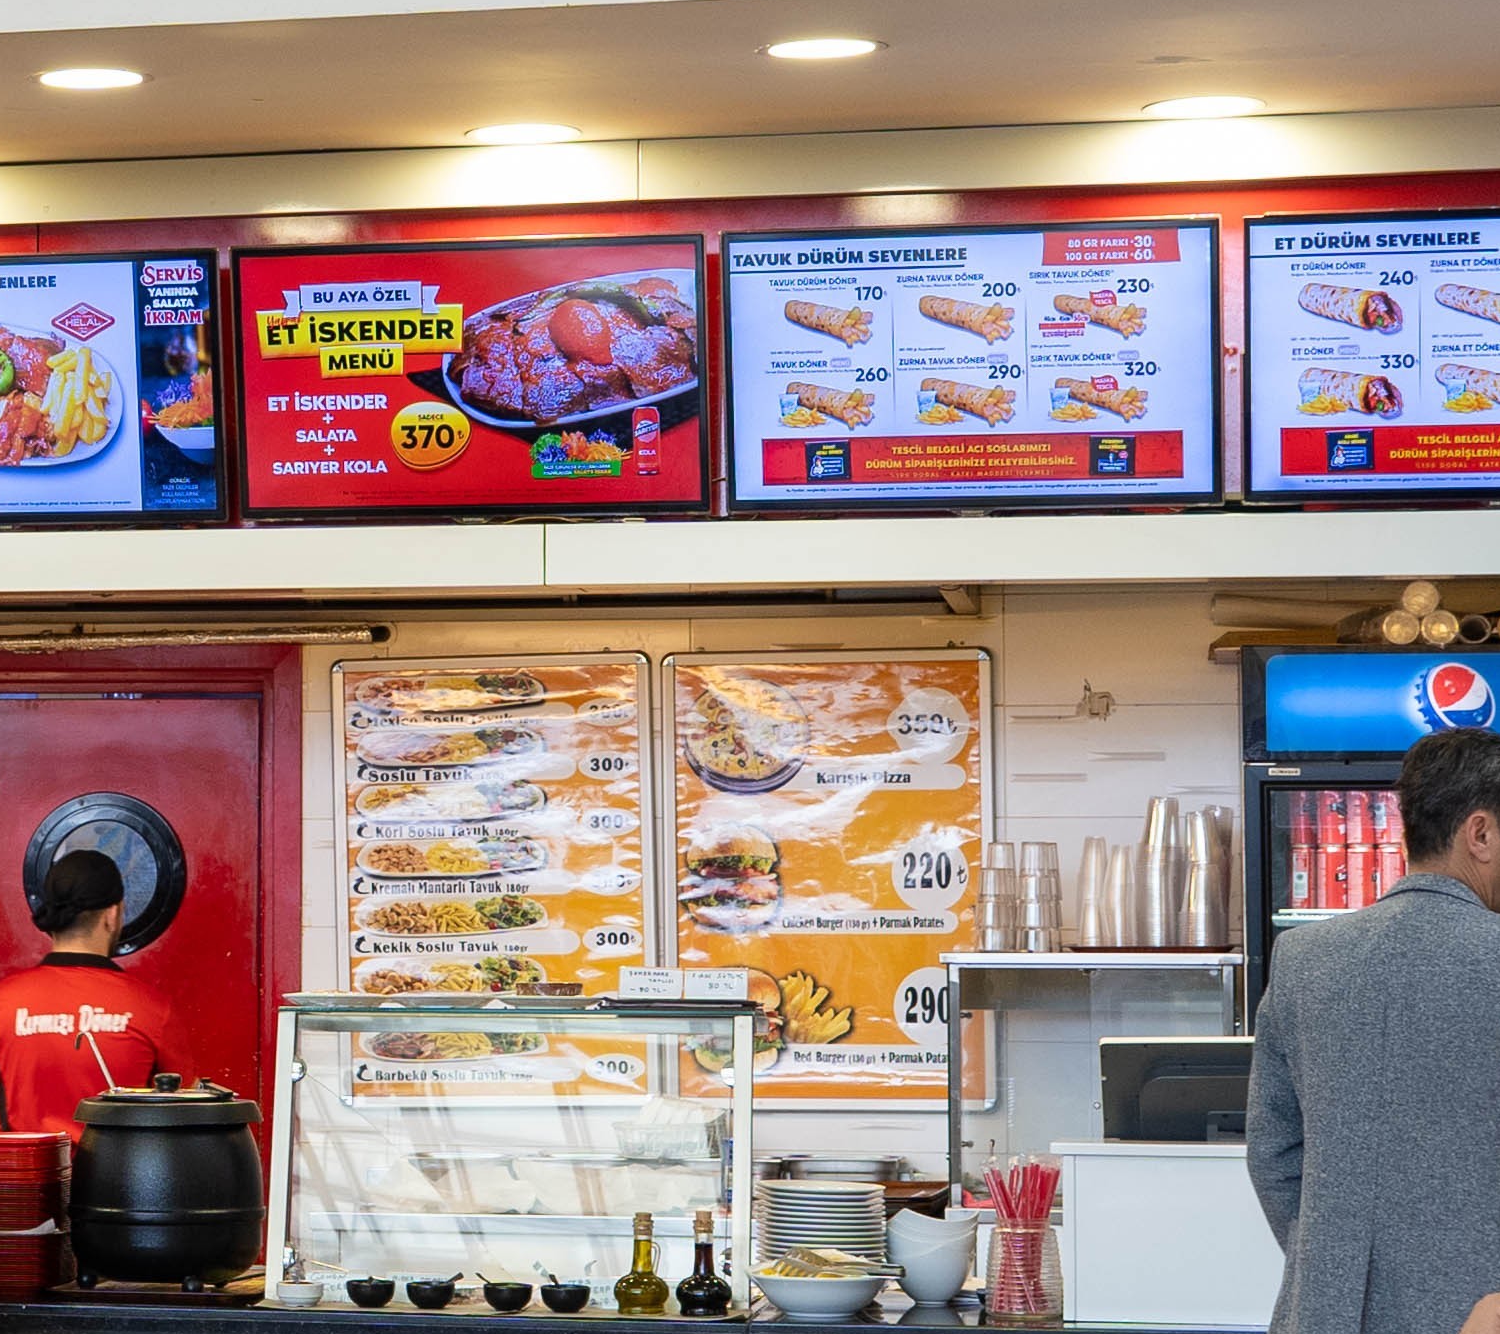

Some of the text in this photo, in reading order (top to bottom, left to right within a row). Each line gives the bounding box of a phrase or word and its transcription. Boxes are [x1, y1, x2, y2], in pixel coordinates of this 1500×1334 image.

[1275, 232, 1481, 250] ET DÜRÜM SEVENLERE
[733, 248, 968, 267] TAVUK DÜRÜM SEVENLERE
[141, 265, 203, 286] SERVİS
[147, 287, 198, 298] YANINDA
[313, 287, 411, 304] BU AYA ÖZEL
[152, 298, 195, 309] SALATA
[144, 306, 203, 326] İKRAM
[267, 316, 454, 346] ET İSKENDER
[329, 349, 394, 370] MENÜ
[268, 391, 388, 411] ET İSKENDER
[296, 429, 357, 442] SALATA
[273, 460, 388, 475] SARIYER KOLA
[369, 770, 416, 783] Soslu
[470, 880, 502, 894] Tavuk
[373, 940, 499, 953] Kekik Soslu Tavuk
[814, 1049, 923, 1065] Burger Parmak
